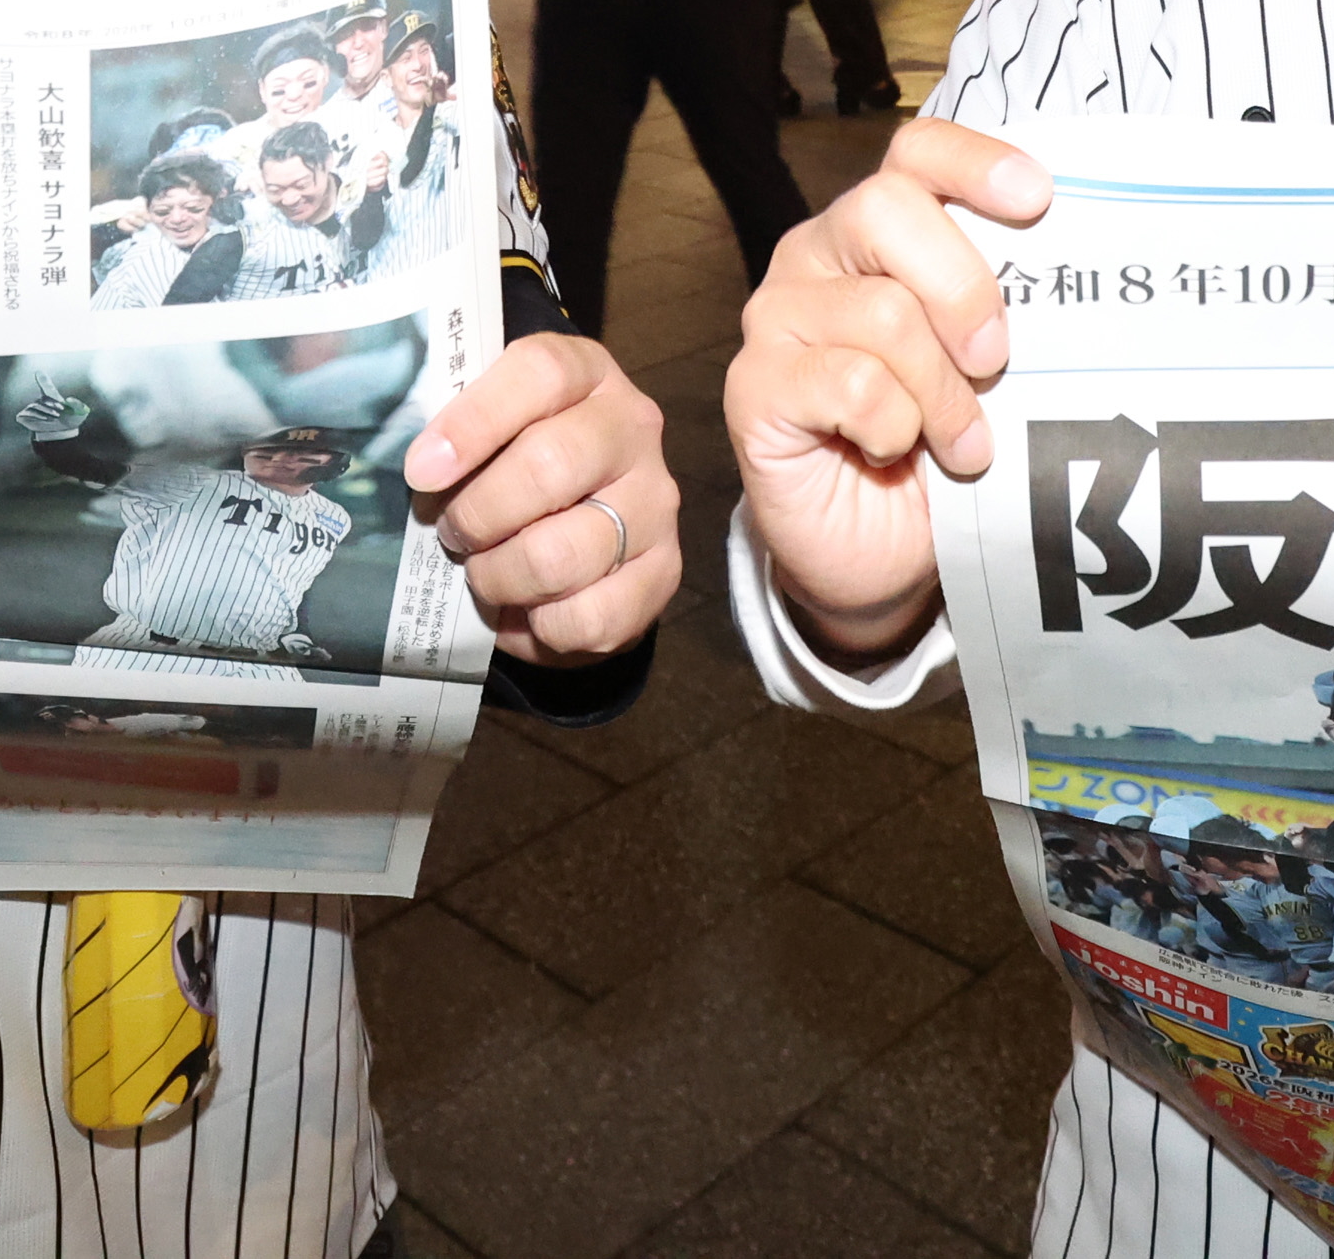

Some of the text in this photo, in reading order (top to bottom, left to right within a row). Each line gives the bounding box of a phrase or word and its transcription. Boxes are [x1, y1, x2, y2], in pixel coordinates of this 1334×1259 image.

[38, 83, 67, 287] 大山歓喜 サヨナラ弾
[447, 307, 467, 376] 森下弾
[1069, 946, 1215, 1022] Joshin
[1157, 954, 1223, 985] 阪神ナイン
